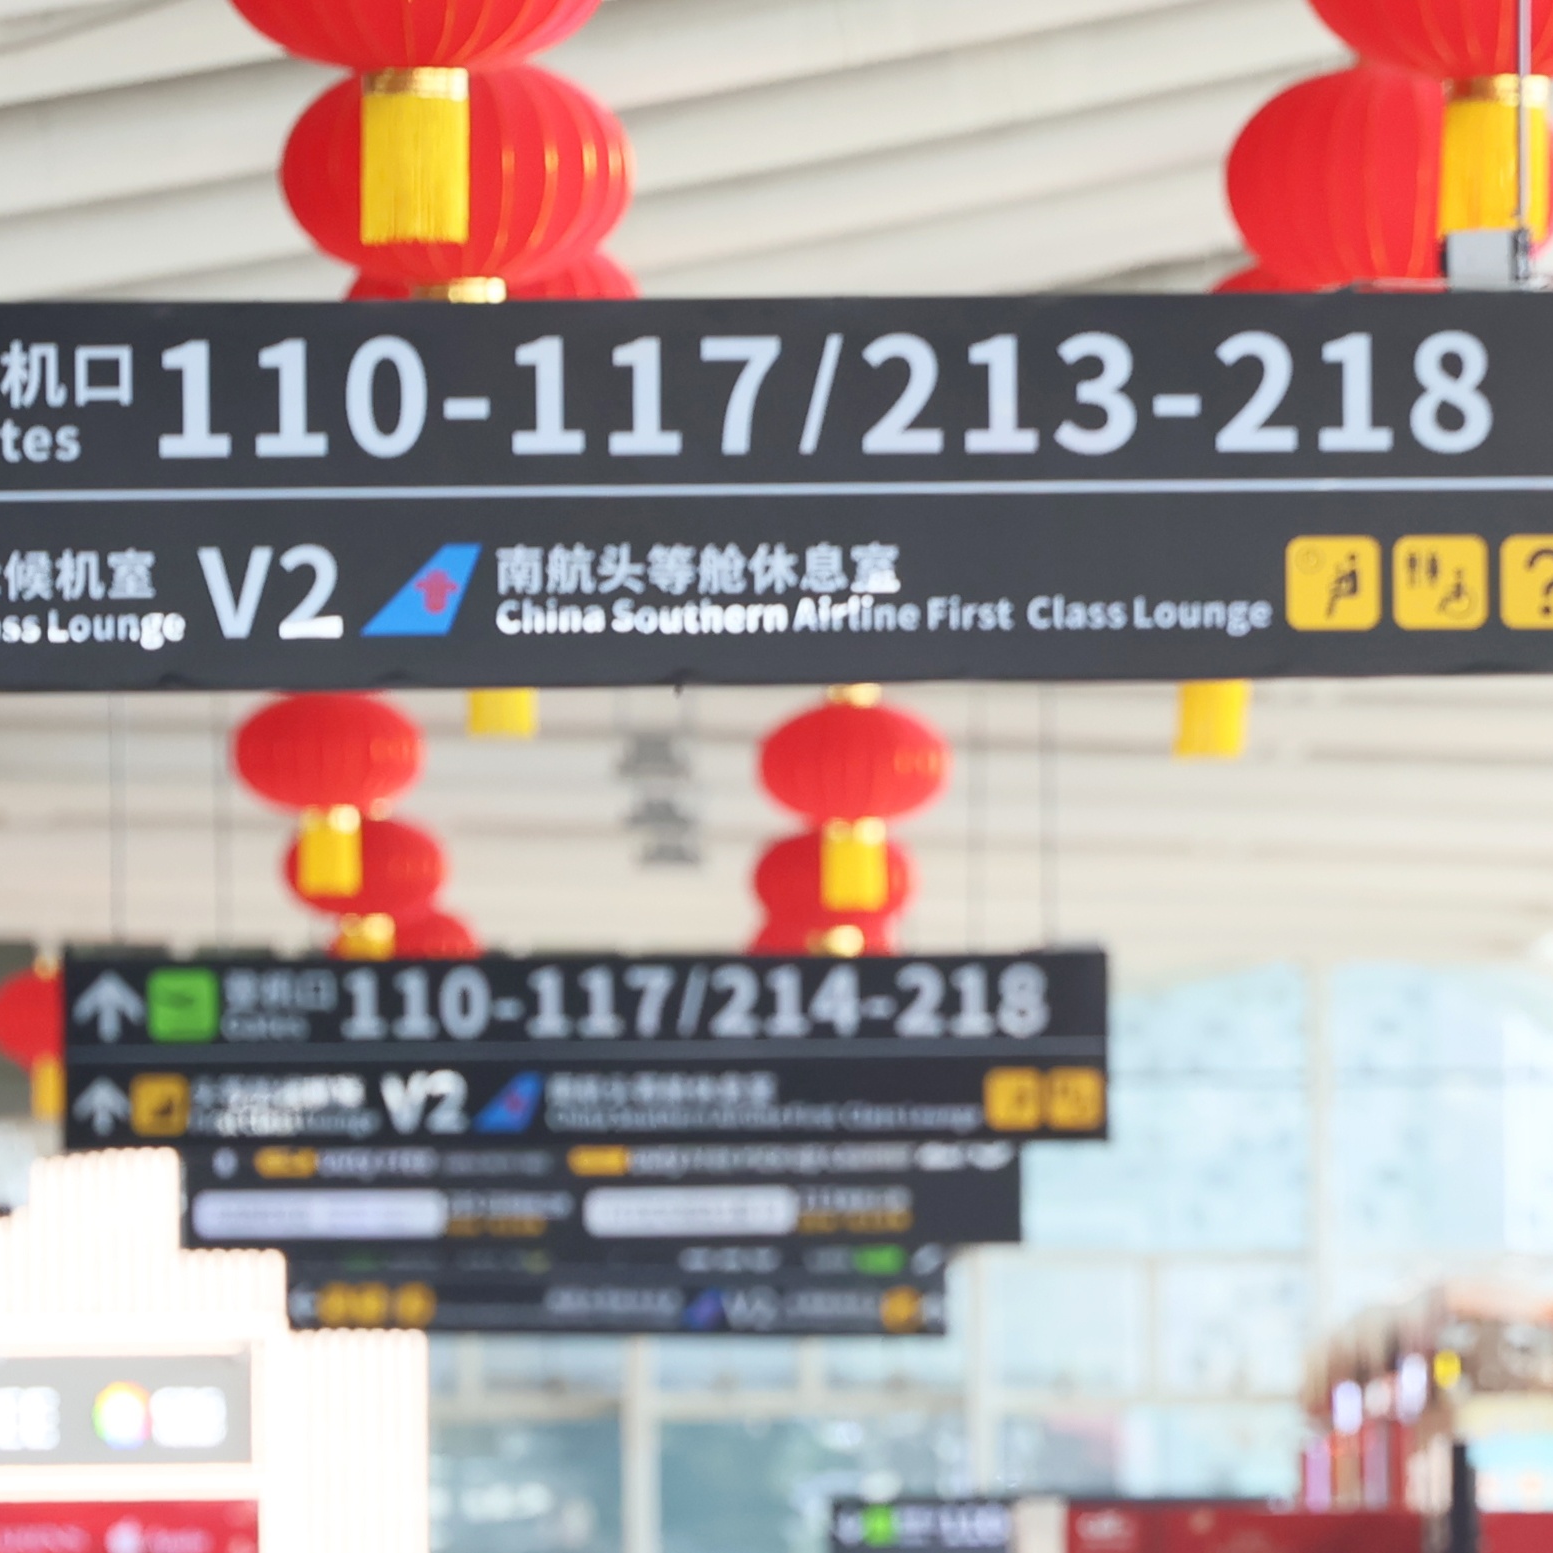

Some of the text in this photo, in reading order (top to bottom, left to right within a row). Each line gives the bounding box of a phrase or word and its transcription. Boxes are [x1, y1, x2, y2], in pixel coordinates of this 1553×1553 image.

[159, 330, 1491, 457] 110-117/213-218
[197, 545, 343, 639] V2
[495, 542, 900, 596] 南航头等舱休息室
[47, 608, 186, 650] Lounge
[495, 594, 1273, 637] China Southern Airline First Class Lounge
[342, 964, 1051, 1041] 110-117/214-218
[380, 1069, 469, 1134] V2
